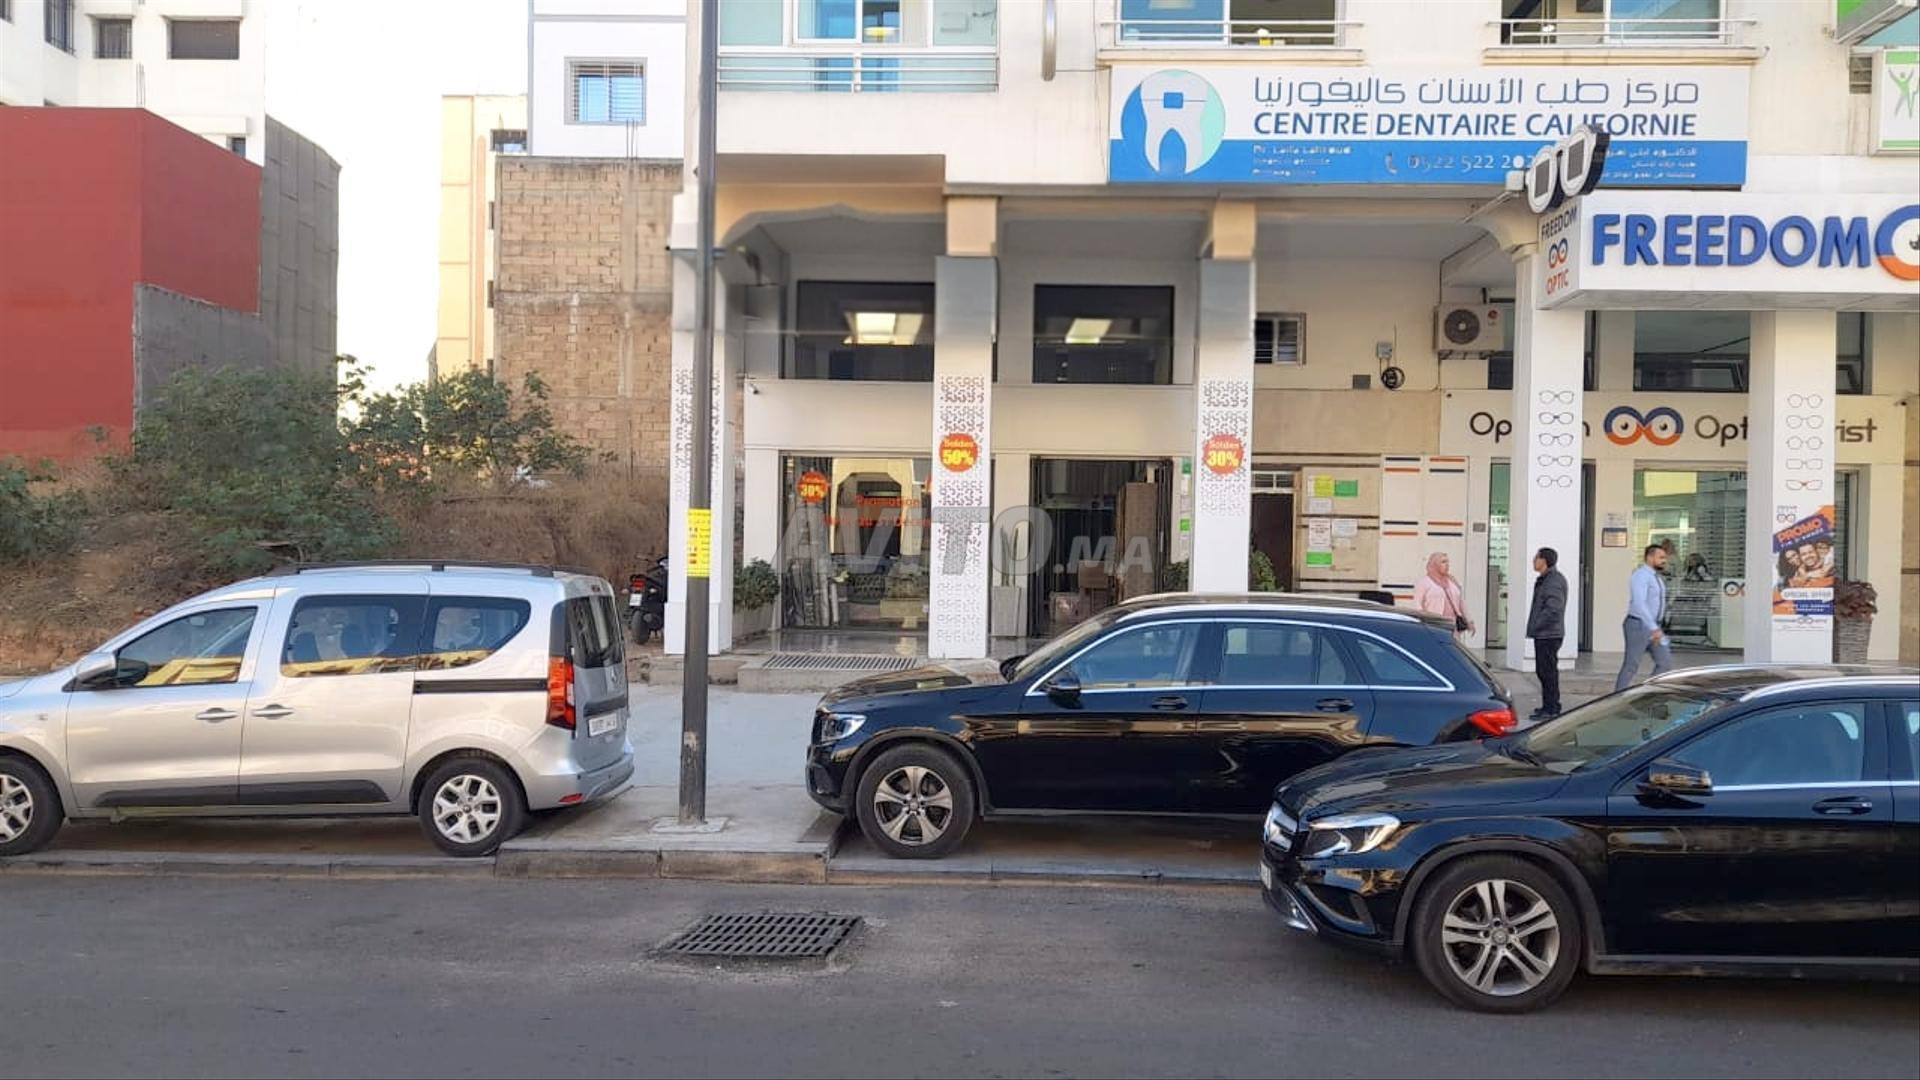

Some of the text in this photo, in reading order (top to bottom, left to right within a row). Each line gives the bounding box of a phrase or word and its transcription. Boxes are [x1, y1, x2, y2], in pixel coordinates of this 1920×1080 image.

[1254, 76, 1699, 108] مركز طب الأسنان كاليفورنيا
[1254, 112, 1369, 135] CENTRE
[1375, 113, 1518, 136] DENTAIRE
[1461, 155, 1494, 173] 522
[1541, 205, 1578, 241] FREEDOM
[1591, 213, 1872, 267] FREEDOM
[1546, 268, 1569, 295] OPTIC
[943, 449, 974, 466] 50%
[1208, 450, 1240, 467] 30%
[800, 484, 825, 498] 30%
[1776, 518, 1823, 544] PROMO
